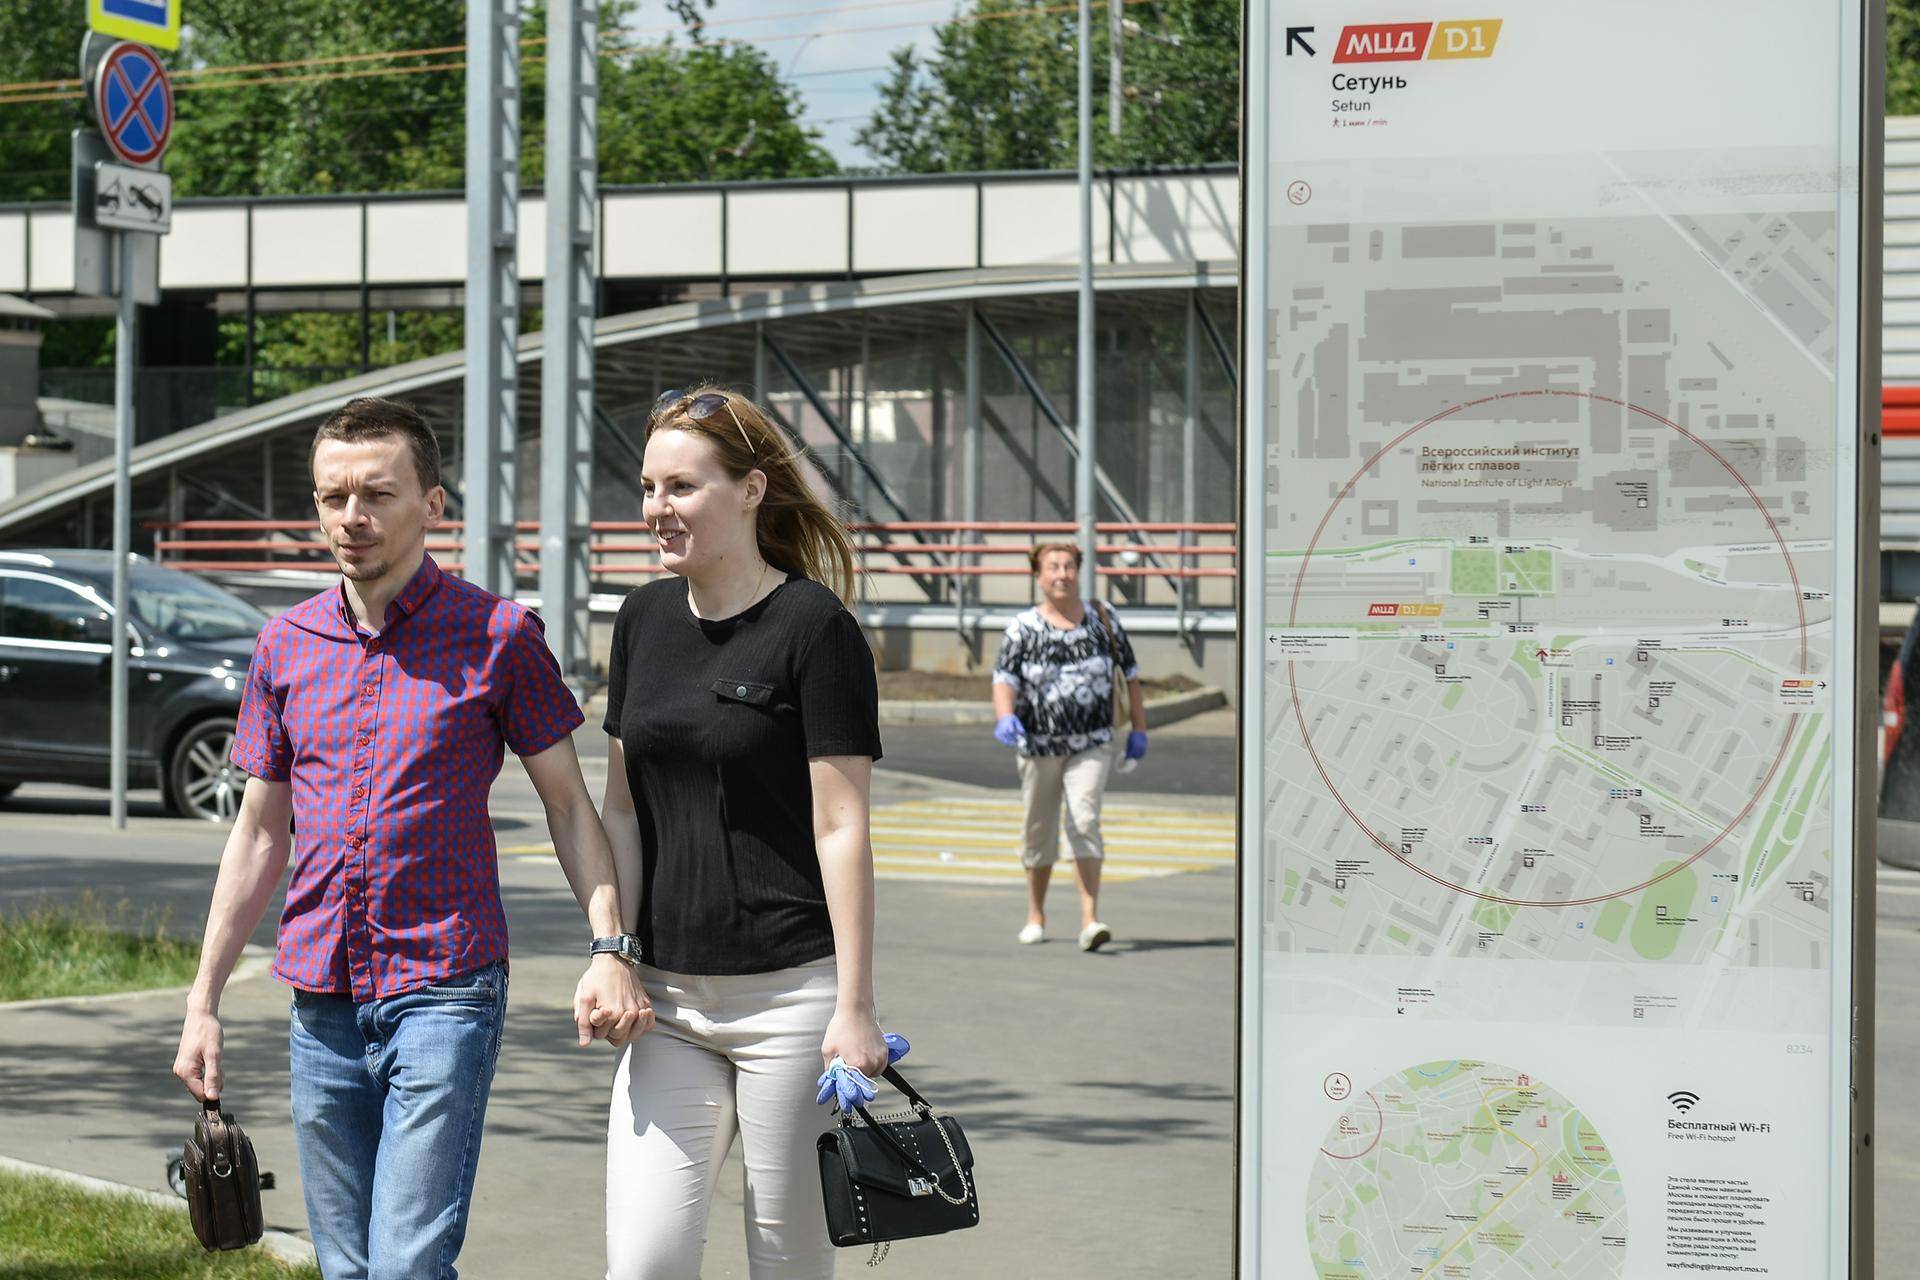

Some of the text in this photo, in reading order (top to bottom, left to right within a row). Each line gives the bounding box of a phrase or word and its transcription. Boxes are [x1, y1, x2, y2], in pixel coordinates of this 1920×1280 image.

[1345, 26, 1486, 55] МЦД D1
[1332, 73, 1408, 94] Сетунь
[1331, 99, 1371, 112] Setun
[1421, 445, 1580, 459] Всероссийский институт
[1421, 459, 1521, 471] лёгких сплавов
[1421, 478, 1573, 490] National Institute of Light Alloys
[1667, 1119, 1771, 1134] Бесплатный Wi-Fi
[1667, 1132, 1736, 1143] Free Wi-Fi hotspot
[1666, 1261, 1769, 1274] wayfinding@transport.mos.ru
